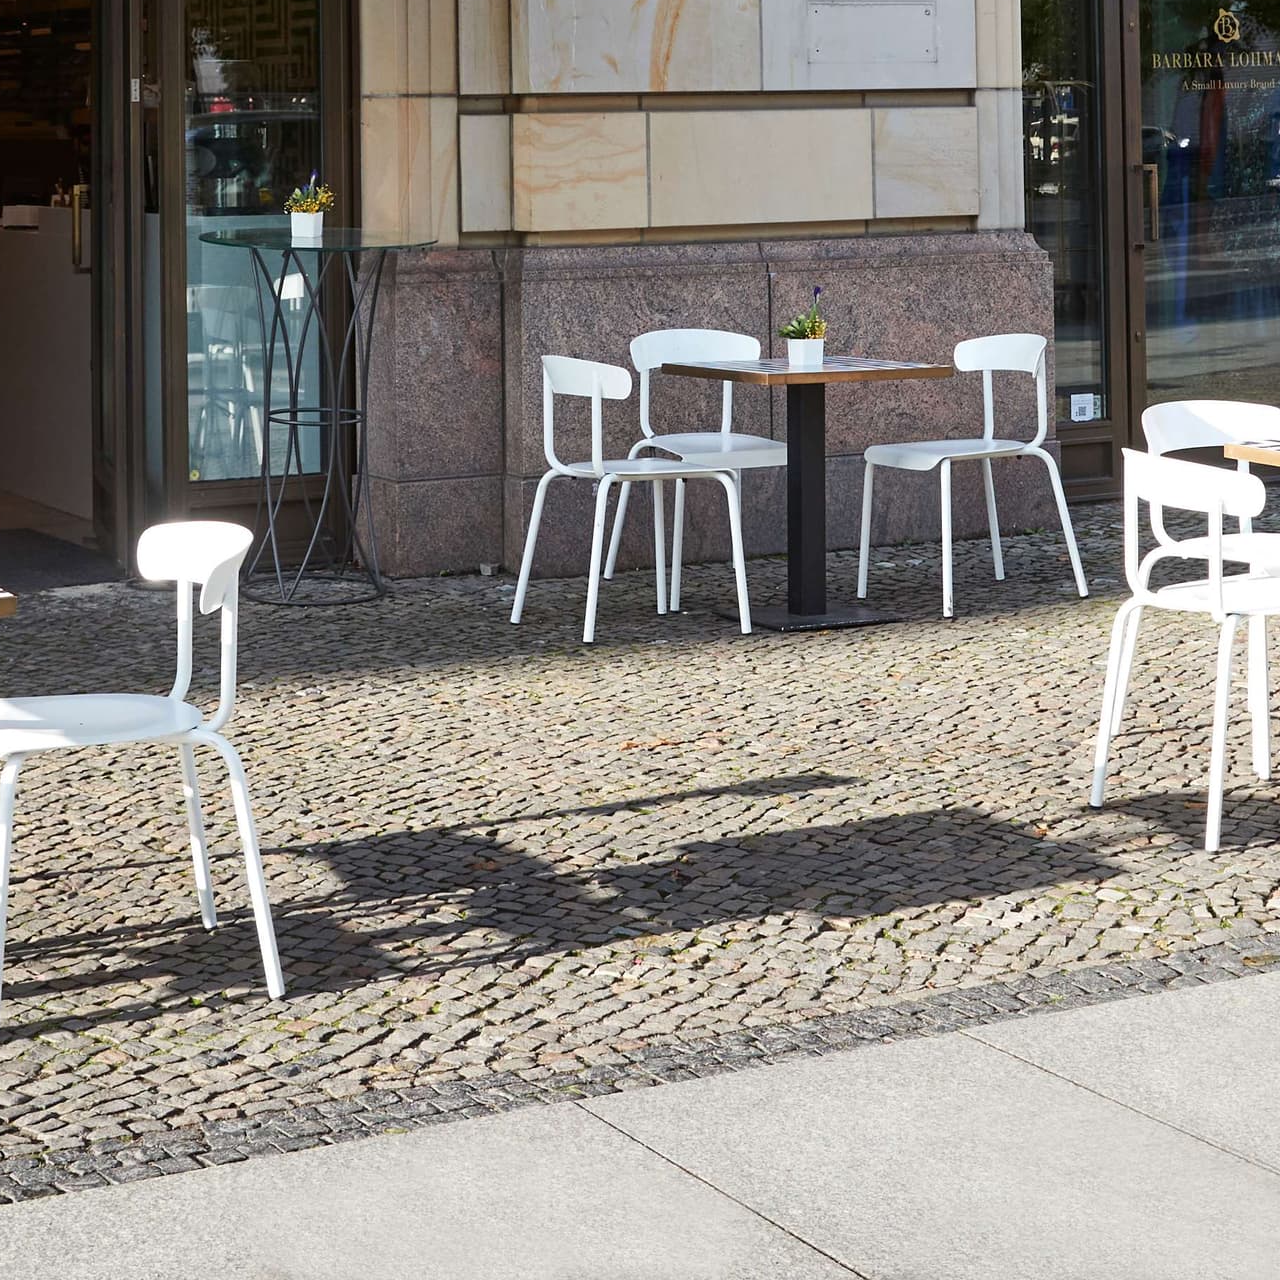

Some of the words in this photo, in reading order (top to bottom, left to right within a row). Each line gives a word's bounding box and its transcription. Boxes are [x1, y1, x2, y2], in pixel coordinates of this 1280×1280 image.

[1151, 52, 1224, 69] BARBARA
[1182, 80, 1190, 90] A
[1192, 79, 1216, 90] Small
[1218, 79, 1248, 92] Luxury
